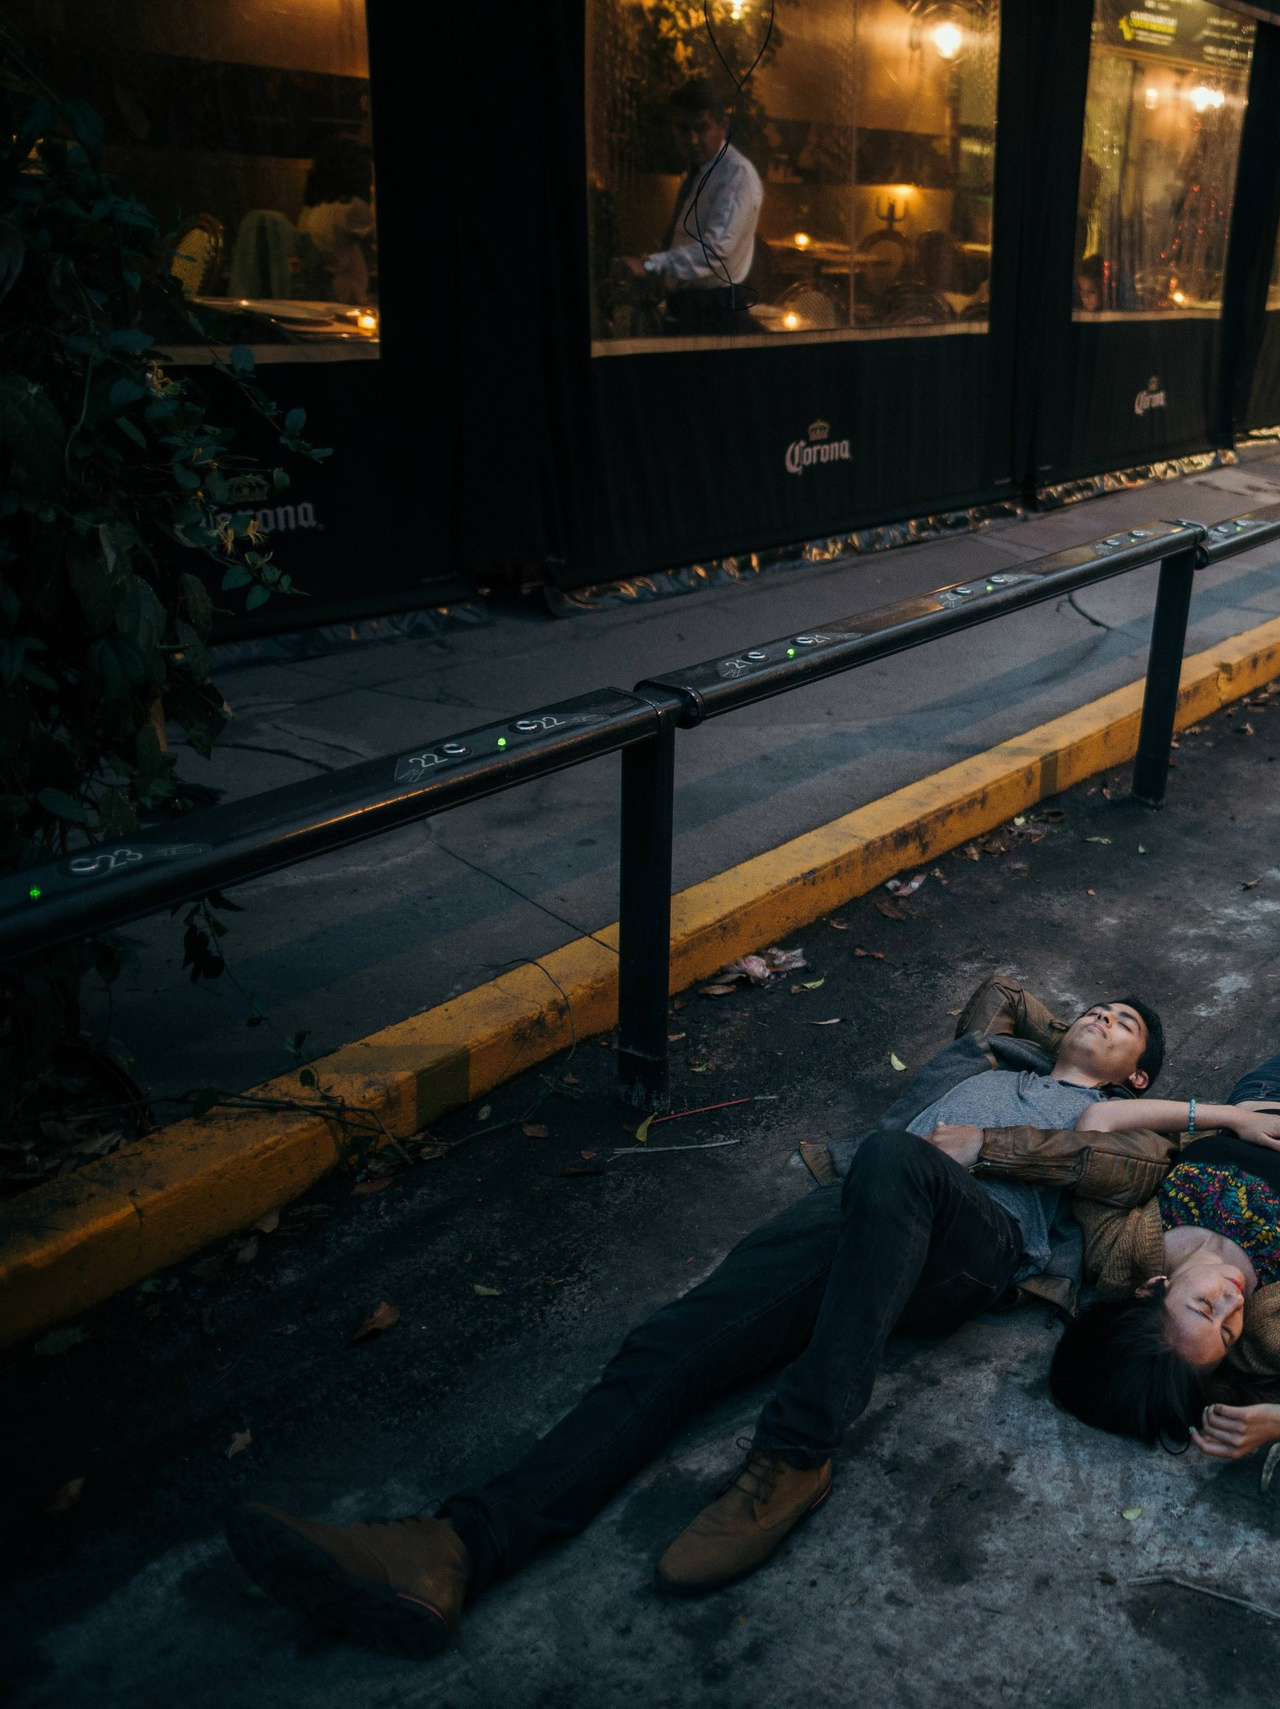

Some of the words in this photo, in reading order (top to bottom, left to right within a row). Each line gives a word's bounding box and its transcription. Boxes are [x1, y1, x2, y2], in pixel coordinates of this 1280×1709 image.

[785, 439, 851, 476] Corona
[199, 501, 318, 538] Cona
[725, 659, 753, 669] 21
[533, 716, 566, 729] 22
[409, 753, 448, 768] 22
[96, 849, 143, 868] 23
